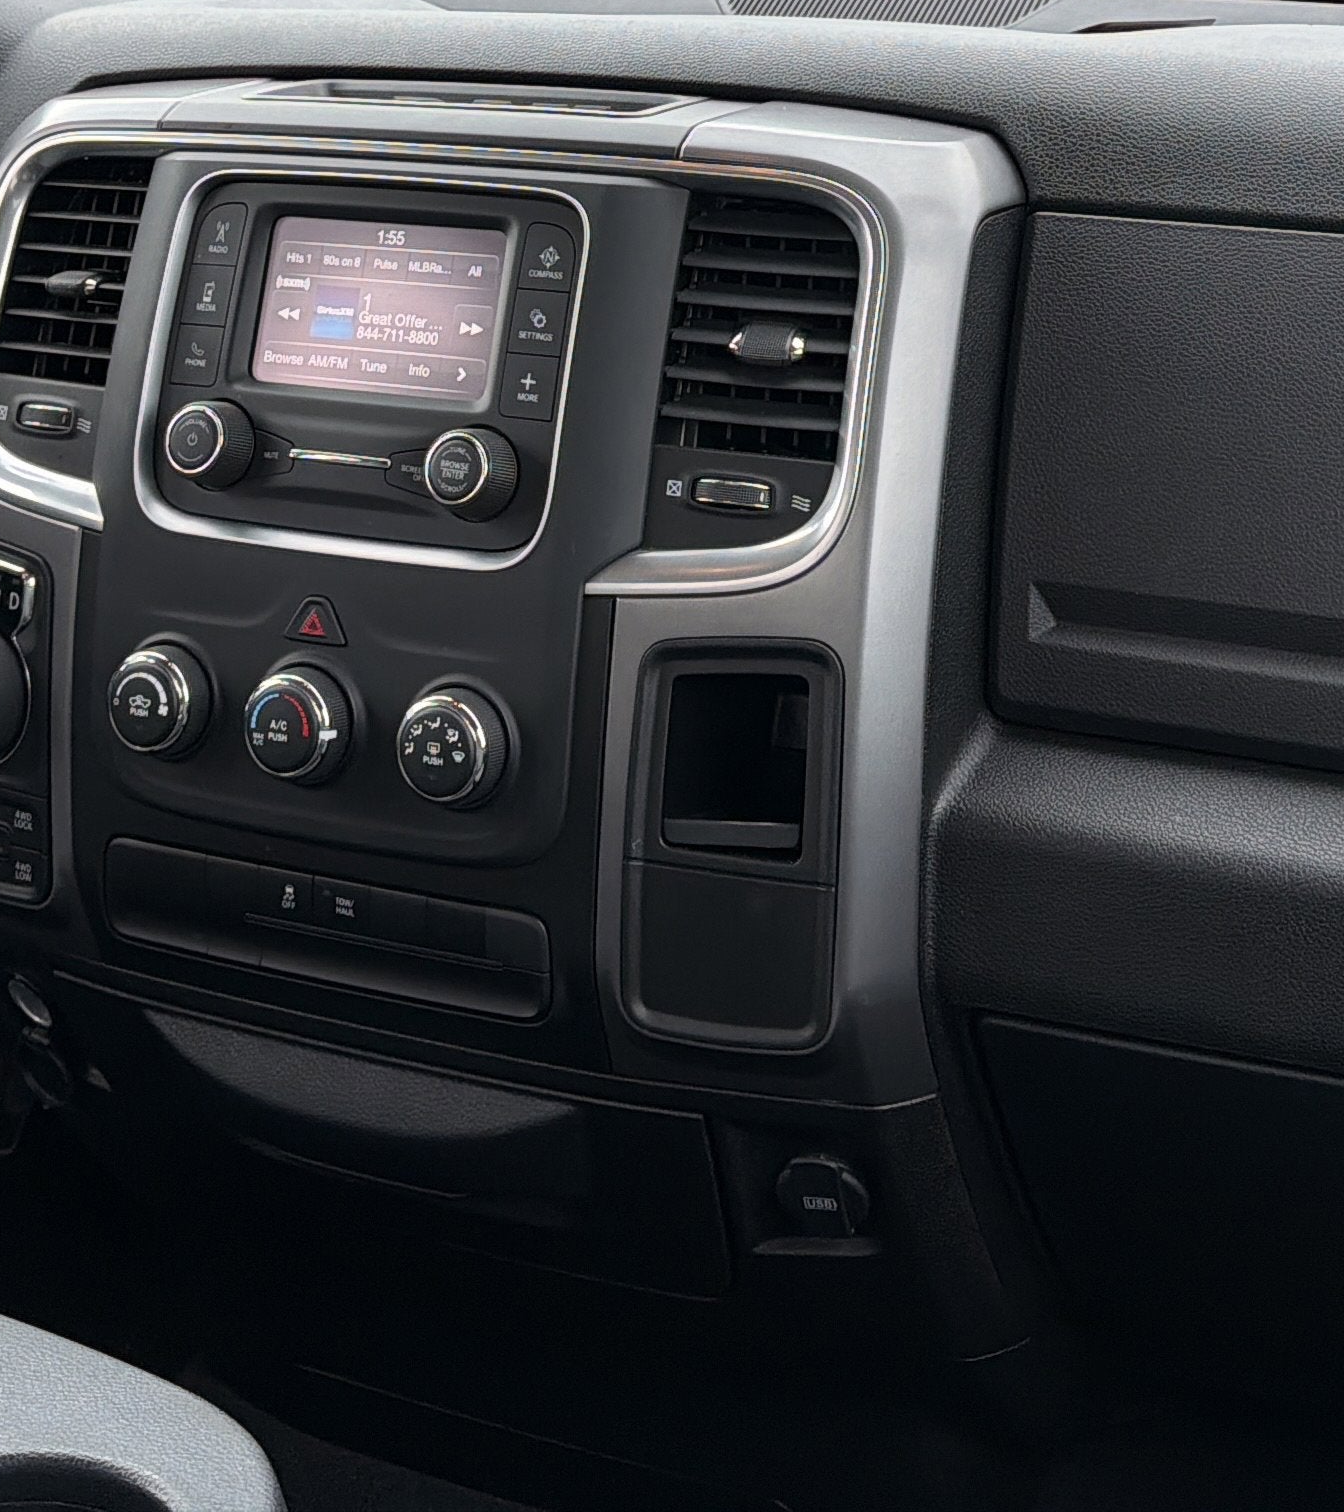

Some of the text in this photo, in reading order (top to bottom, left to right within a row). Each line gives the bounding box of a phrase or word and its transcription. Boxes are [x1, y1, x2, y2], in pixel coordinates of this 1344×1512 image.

[377, 229, 406, 247] 1:55
[208, 244, 228, 255] RADIO
[286, 252, 305, 265] Hits
[323, 253, 340, 267] 80s
[373, 257, 398, 272] Pulse
[468, 264, 483, 279] All
[528, 268, 564, 280] COMPASS
[196, 302, 217, 313] MEDIA
[364, 294, 372, 311] 1
[358, 310, 392, 327] Great
[395, 312, 428, 329] Offer
[356, 325, 440, 347] 844-711-8800
[518, 330, 554, 342] SETTINGS
[185, 357, 207, 368] PHONE
[264, 350, 431, 378] Browse AM/FM Tune Info
[517, 392, 539, 403] MORE
[263, 451, 280, 460] MUTE
[440, 460, 470, 471] BROWSE
[442, 469, 465, 480] ENTER
[9, 592, 20, 610] D
[129, 707, 149, 719] PUSH
[269, 719, 287, 732] A/C
[268, 731, 288, 744] PUSH
[422, 754, 444, 767] PUSH
[15, 809, 33, 821] 4WD
[14, 819, 33, 832] LOCK
[15, 861, 32, 873] 4WD
[15, 871, 32, 882] LOW
[281, 898, 295, 910] OFF
[335, 896, 355, 908] TOW/
[335, 906, 355, 918] HAUL
[808, 1197, 833, 1210] USB
